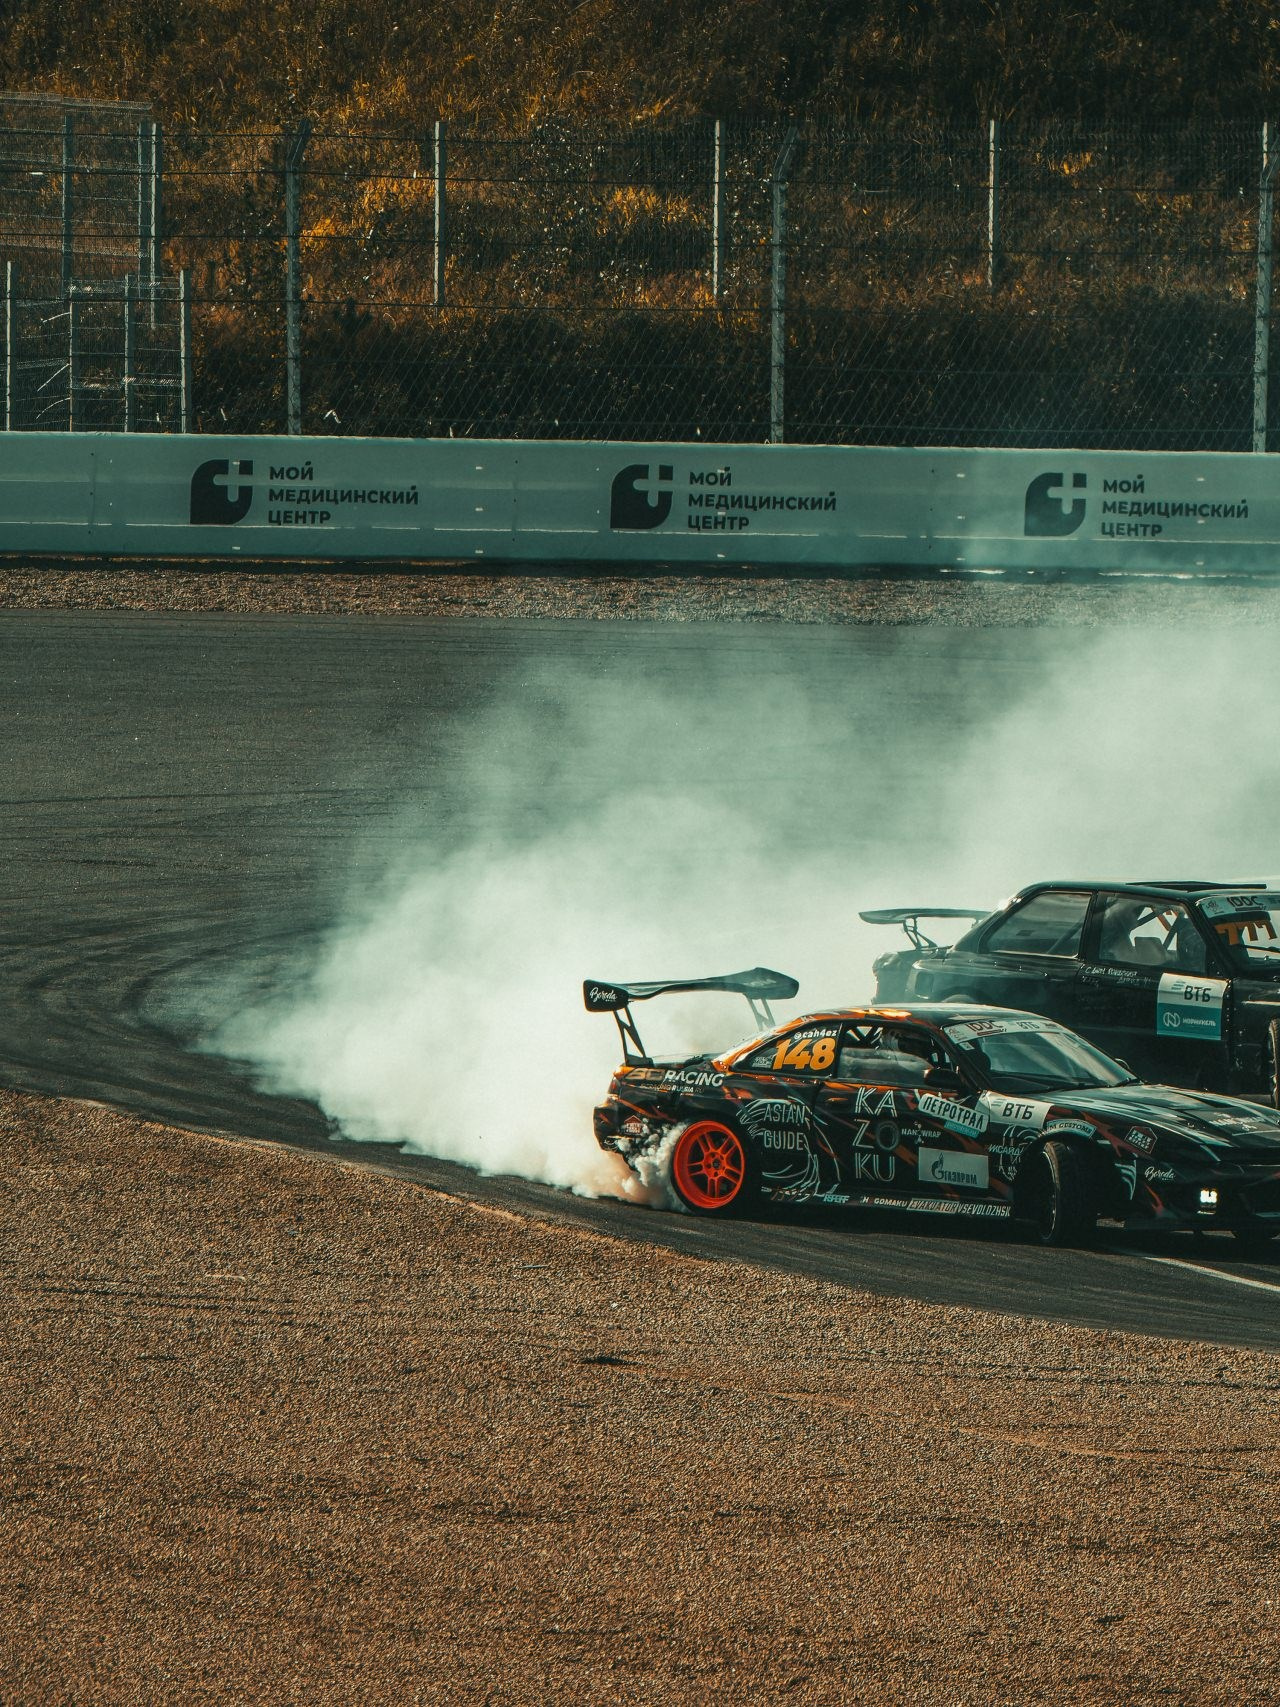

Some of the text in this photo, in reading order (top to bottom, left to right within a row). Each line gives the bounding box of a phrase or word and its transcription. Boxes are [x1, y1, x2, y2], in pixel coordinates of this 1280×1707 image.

[269, 461, 314, 480] МОЙ
[689, 467, 732, 486] МОЙ
[1103, 474, 1145, 493] МОЙ
[268, 486, 419, 505] МЕДИЦИНСКИЙ
[687, 491, 837, 511] МЕДИЦИНСКИЙ
[267, 510, 332, 525] ЦЕНТР
[1102, 499, 1249, 518] МЕДИЦИНСКИЙ
[687, 515, 750, 531] ЦЕНТР
[1100, 522, 1164, 537] ЦЕНТР
[1214, 919, 1278, 946] 777
[1184, 985, 1212, 1002] ВТБ
[772, 1037, 836, 1070] 148
[661, 1069, 726, 1087] RACING
[855, 1086, 898, 1118] KA
[1002, 1102, 1035, 1120] ВТБ
[763, 1103, 806, 1124] ASIAN
[922, 1096, 984, 1130] ПЕТРОТРАЛ
[763, 1130, 804, 1150] GUIDE
[855, 1152, 896, 1182] KU
